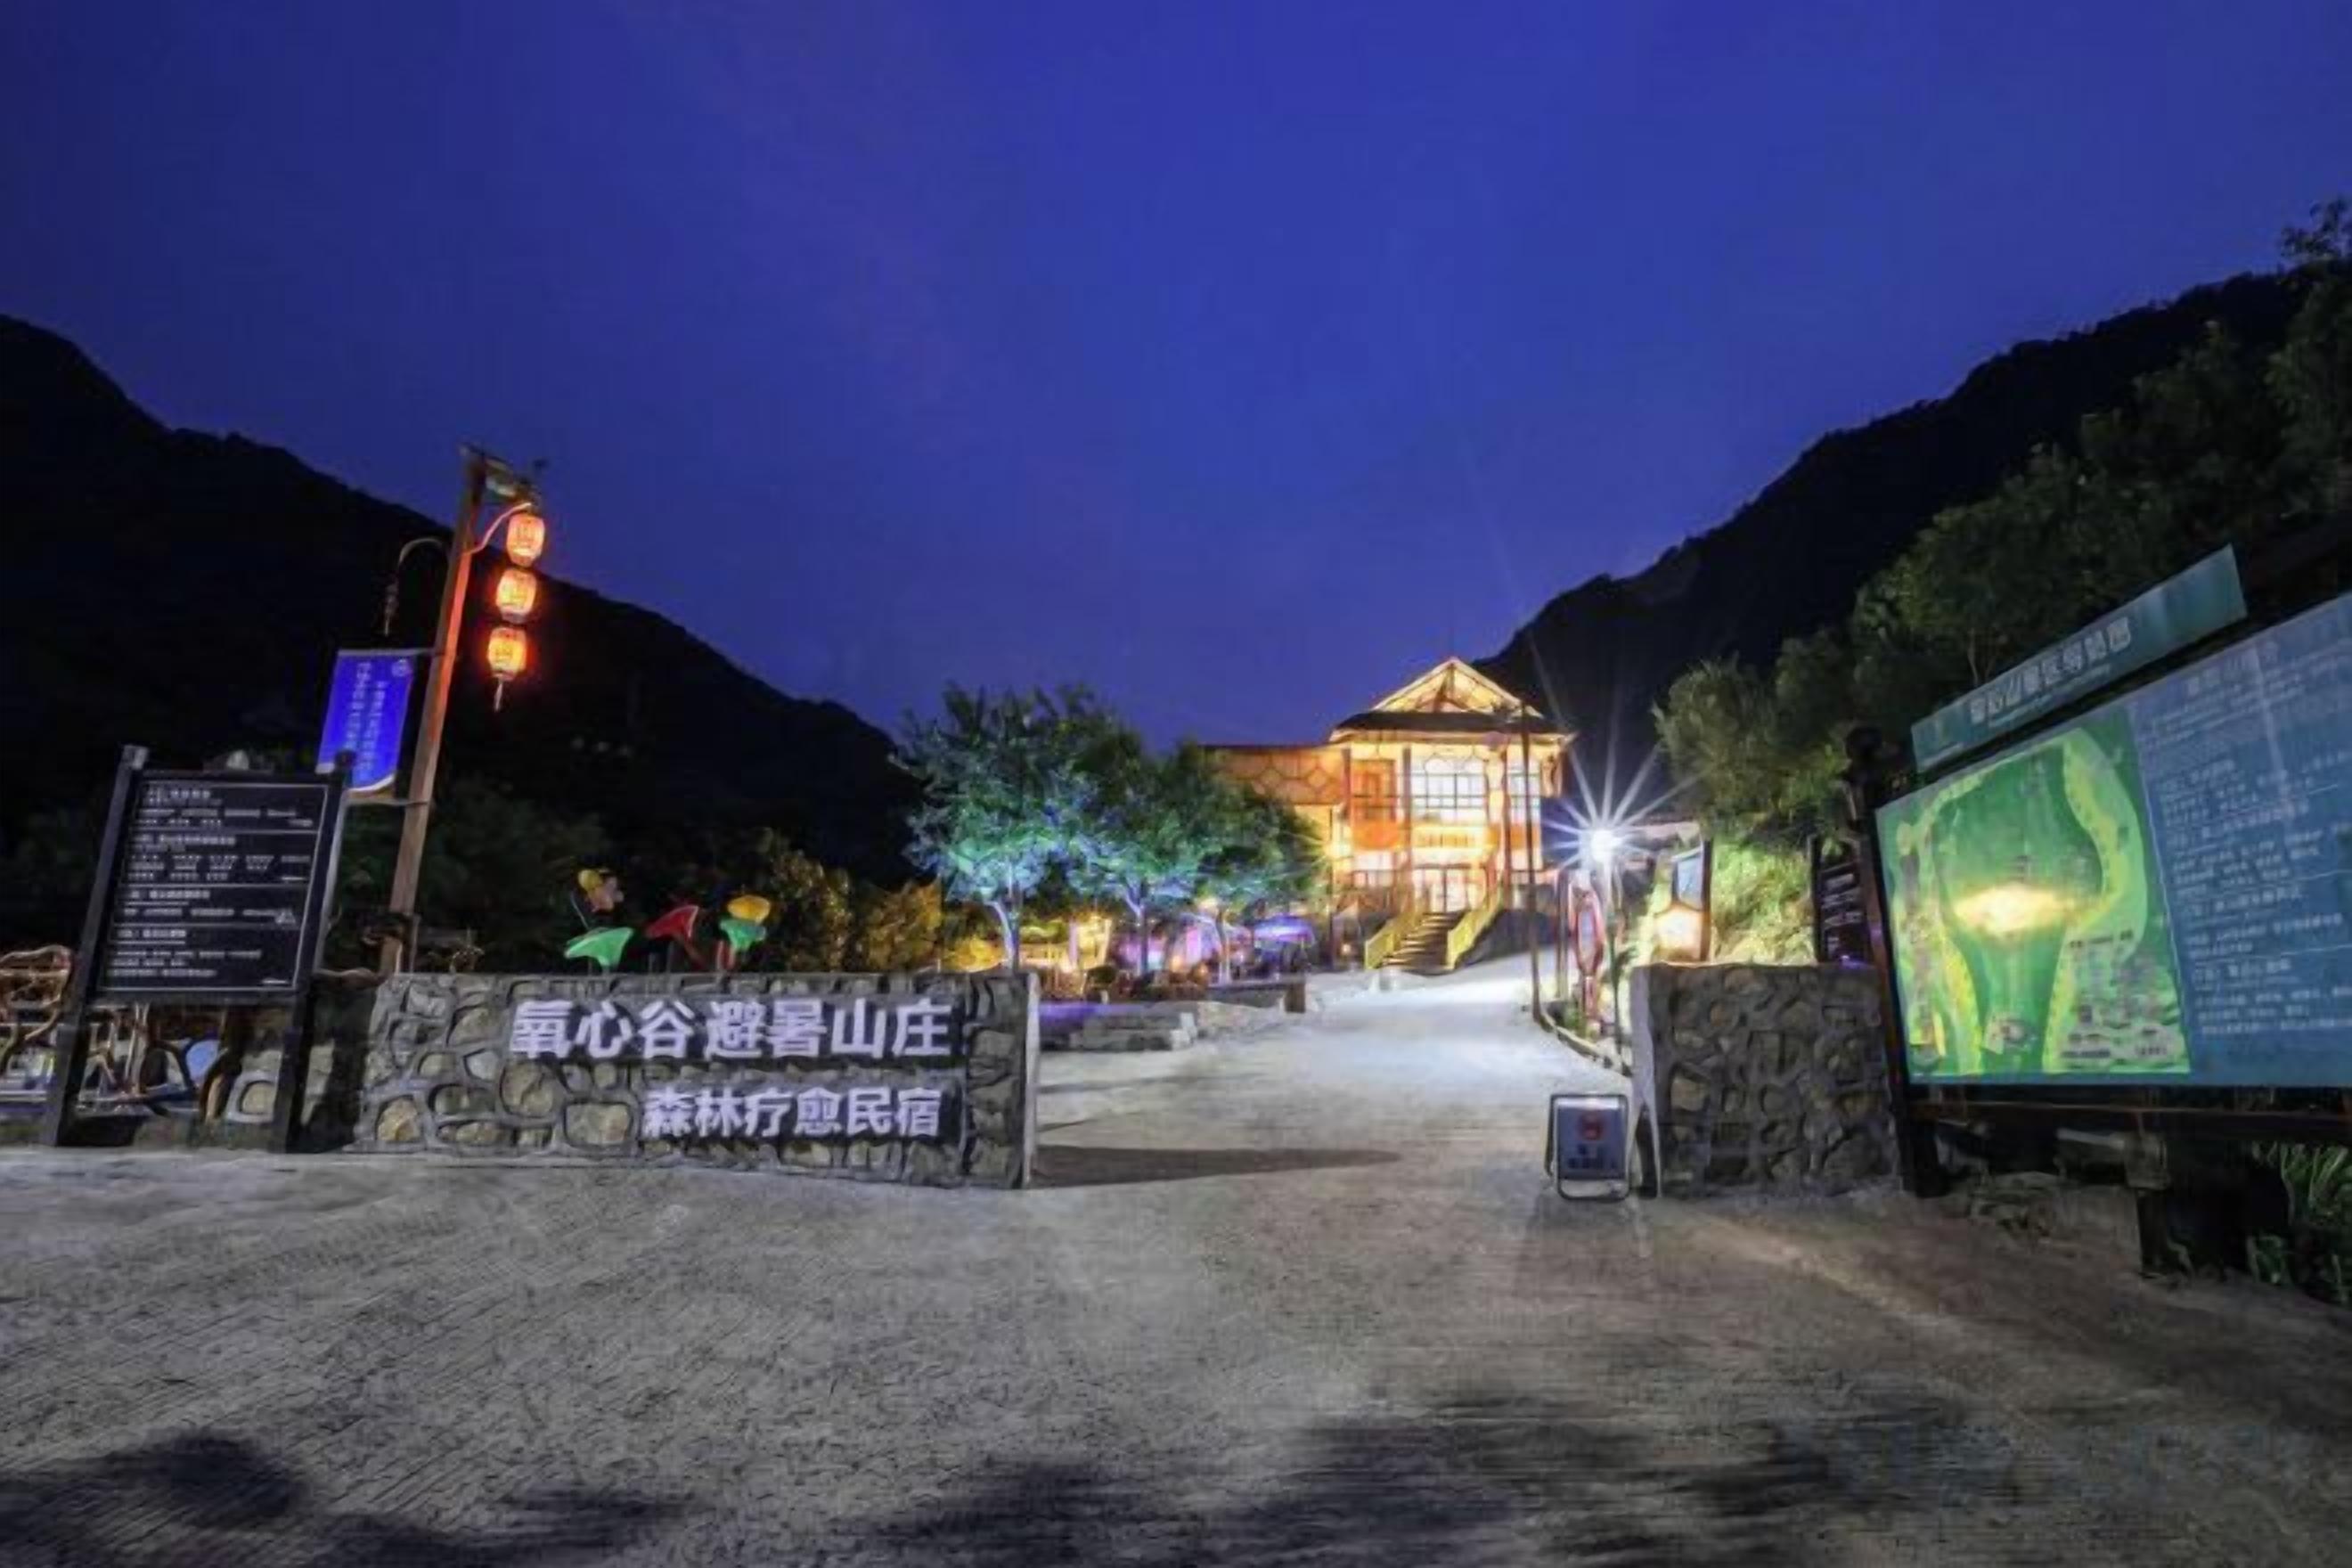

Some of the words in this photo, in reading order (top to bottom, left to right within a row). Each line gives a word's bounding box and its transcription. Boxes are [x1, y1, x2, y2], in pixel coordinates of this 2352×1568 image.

[512, 998, 951, 1059] 氧心谷避暑山庄
[642, 1086, 942, 1139] 森林疗愈民宿
